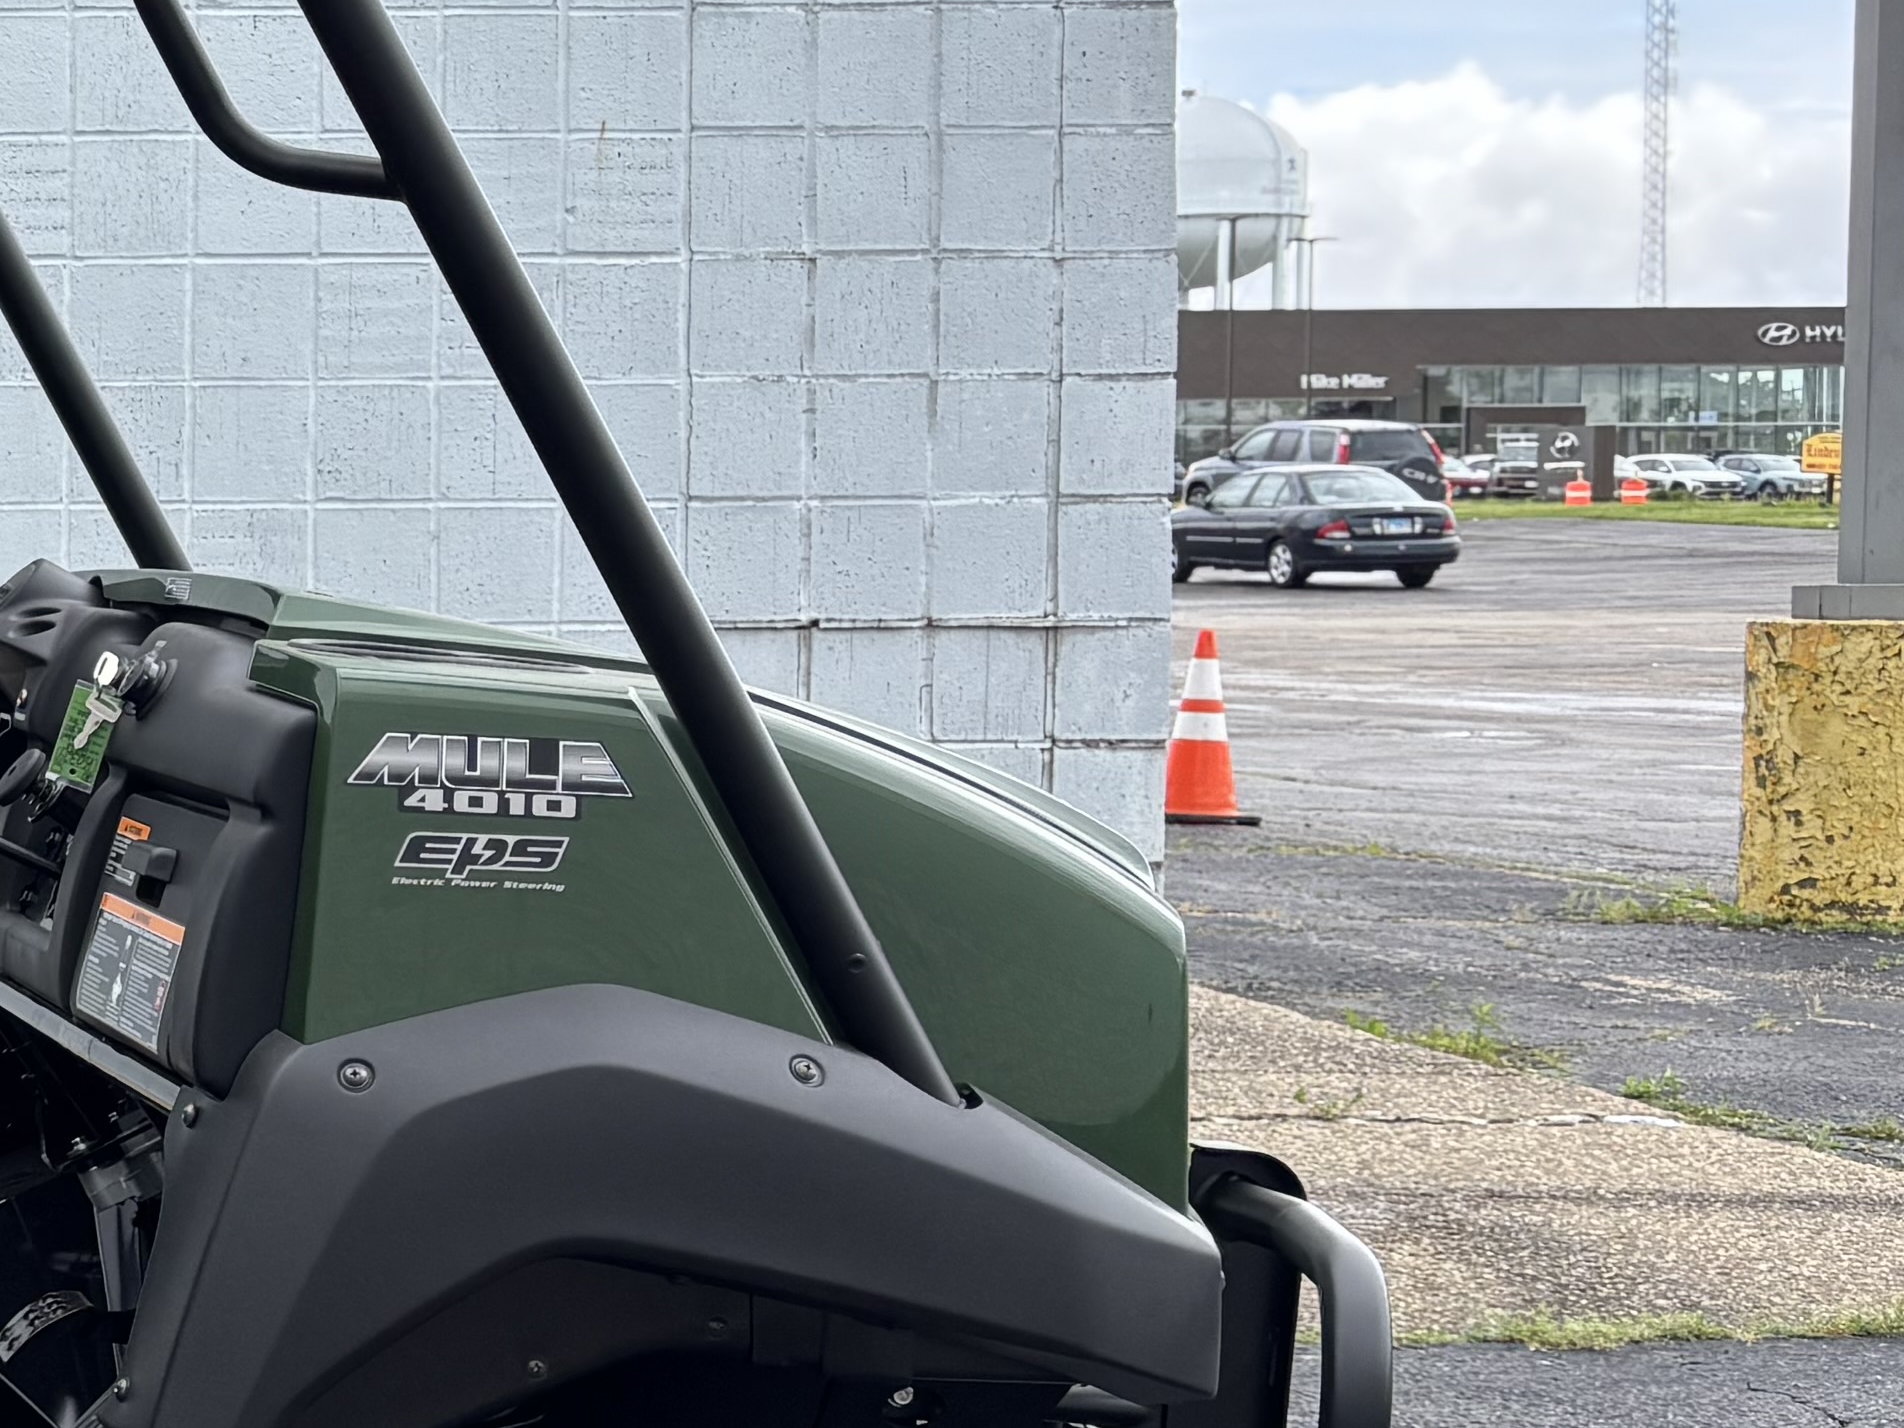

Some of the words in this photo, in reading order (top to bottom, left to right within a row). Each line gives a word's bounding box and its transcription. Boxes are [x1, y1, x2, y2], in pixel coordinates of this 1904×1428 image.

[346, 732, 633, 798] MULE
[403, 788, 577, 818] 4010
[391, 876, 445, 887] Electric
[451, 878, 498, 889] Power
[503, 880, 566, 893] Steering
